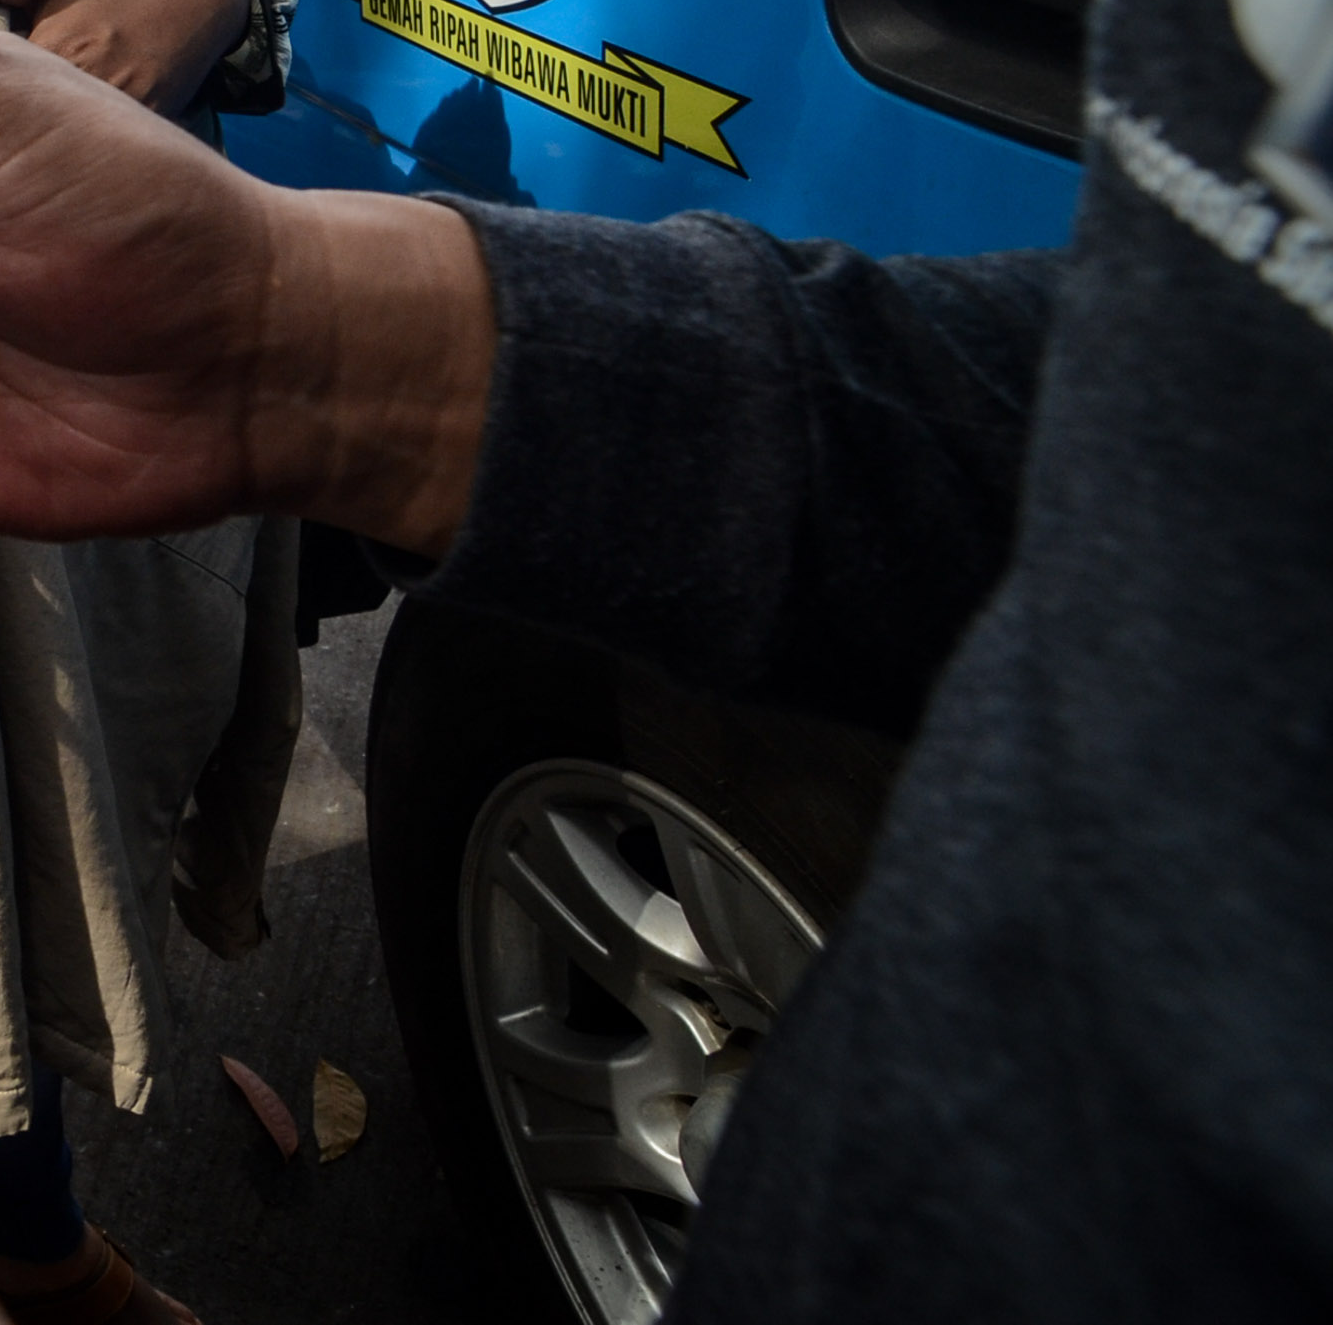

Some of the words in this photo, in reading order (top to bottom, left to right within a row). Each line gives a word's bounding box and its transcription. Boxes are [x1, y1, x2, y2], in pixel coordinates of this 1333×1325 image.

[429, 5, 479, 63] RIPAH
[486, 28, 570, 104] WIBAWA
[577, 68, 646, 138] MUKTI
